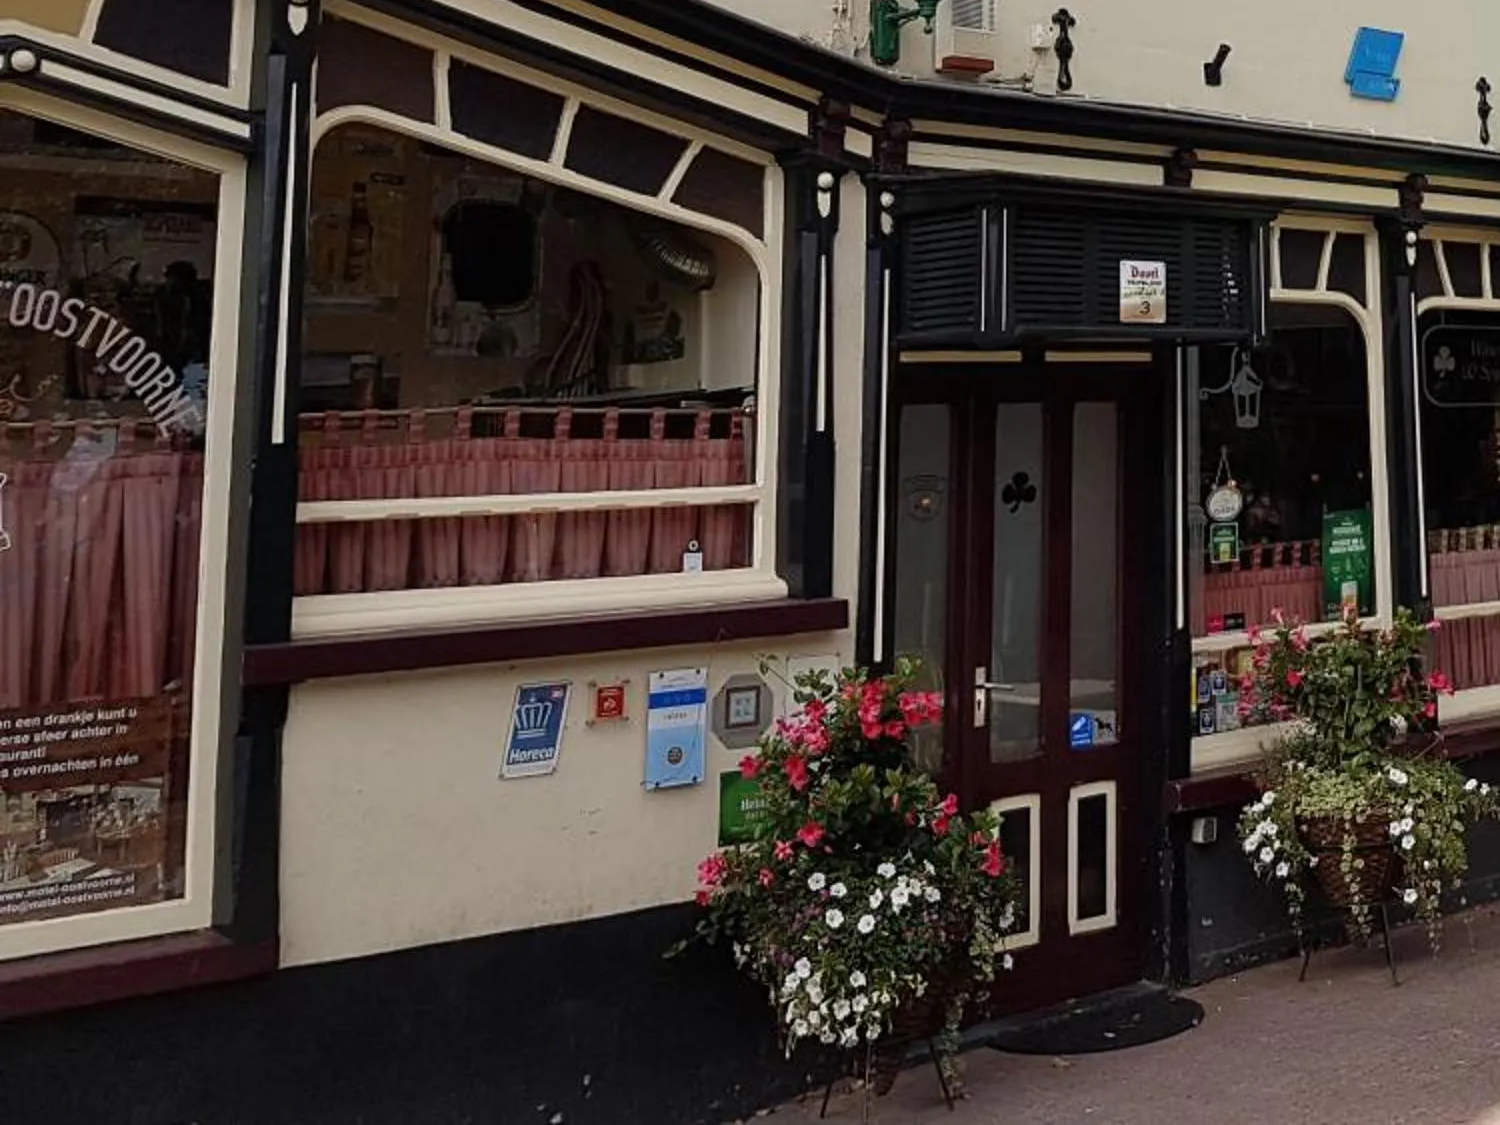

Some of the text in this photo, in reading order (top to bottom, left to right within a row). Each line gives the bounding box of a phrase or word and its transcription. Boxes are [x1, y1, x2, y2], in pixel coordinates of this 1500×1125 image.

[97, 708, 125, 720] kunt
[128, 707, 137, 718] u
[115, 723, 129, 734] in
[508, 747, 555, 764] Horeca
[13, 759, 97, 778] overnachten
[100, 755, 112, 768] in
